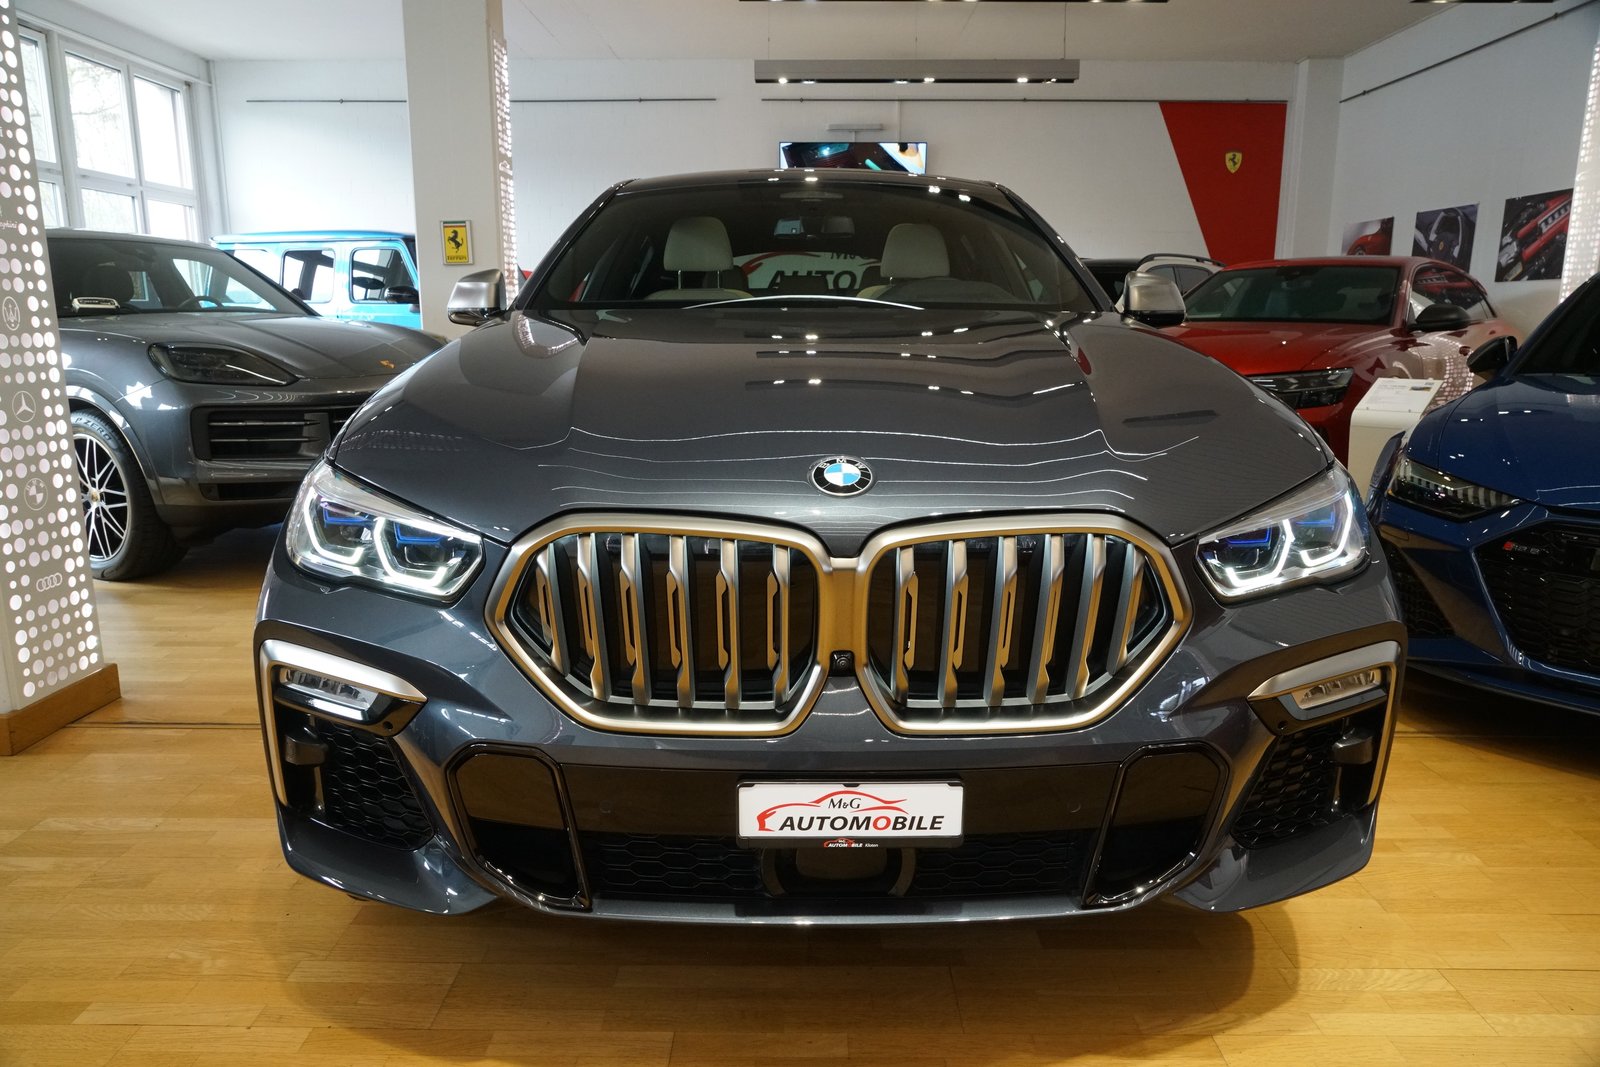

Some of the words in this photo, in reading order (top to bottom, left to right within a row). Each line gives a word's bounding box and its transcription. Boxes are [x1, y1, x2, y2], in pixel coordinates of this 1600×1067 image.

[83, 420, 112, 441] ZERO
[828, 797, 862, 810] M&G
[778, 815, 945, 831] AUTOMOBILE
